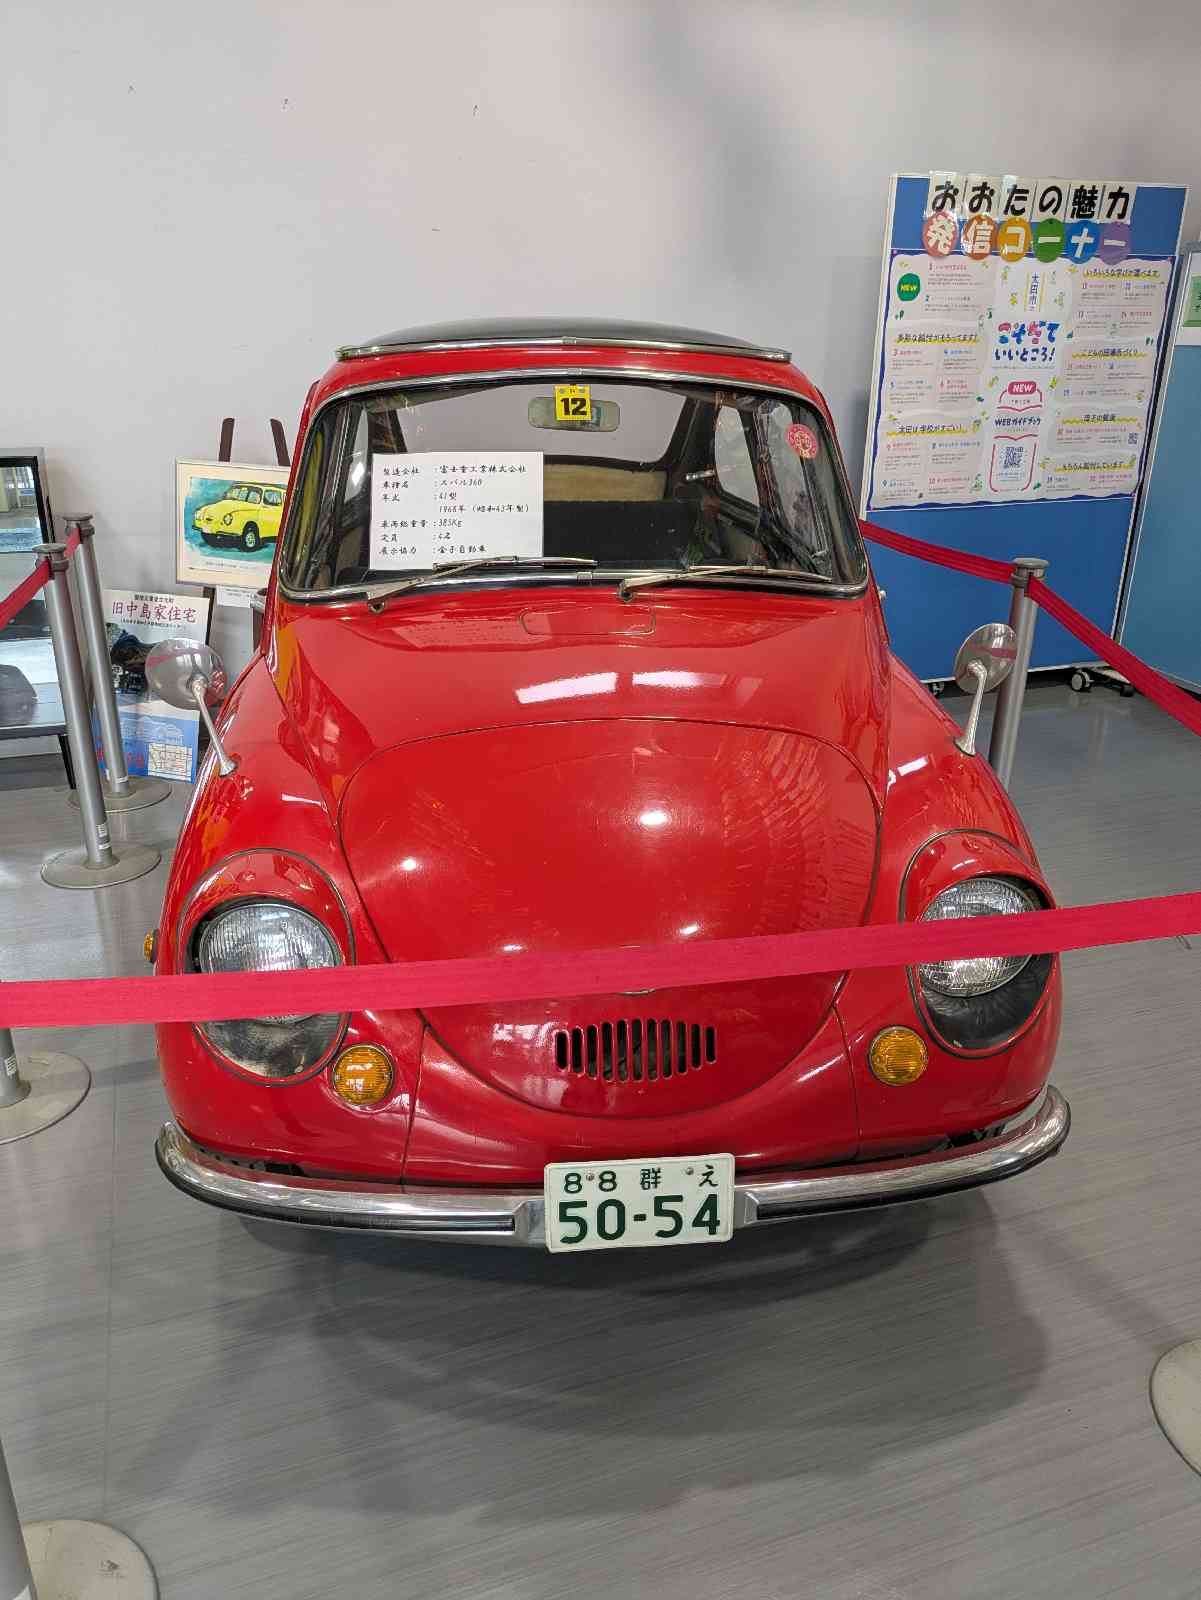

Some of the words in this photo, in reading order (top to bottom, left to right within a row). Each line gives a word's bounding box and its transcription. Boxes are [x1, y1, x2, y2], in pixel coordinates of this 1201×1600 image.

[931, 180, 1131, 220] おおたの魅力
[925, 213, 1127, 258] 発信コーナー
[995, 346, 1056, 362] いいところ!
[1012, 384, 1034, 393] NEW
[560, 397, 587, 416] 12
[112, 601, 198, 623] 旧中島家住宅
[639, 1167, 662, 1190] 群
[699, 1164, 718, 1188] え
[558, 1193, 721, 1245] 50-54
